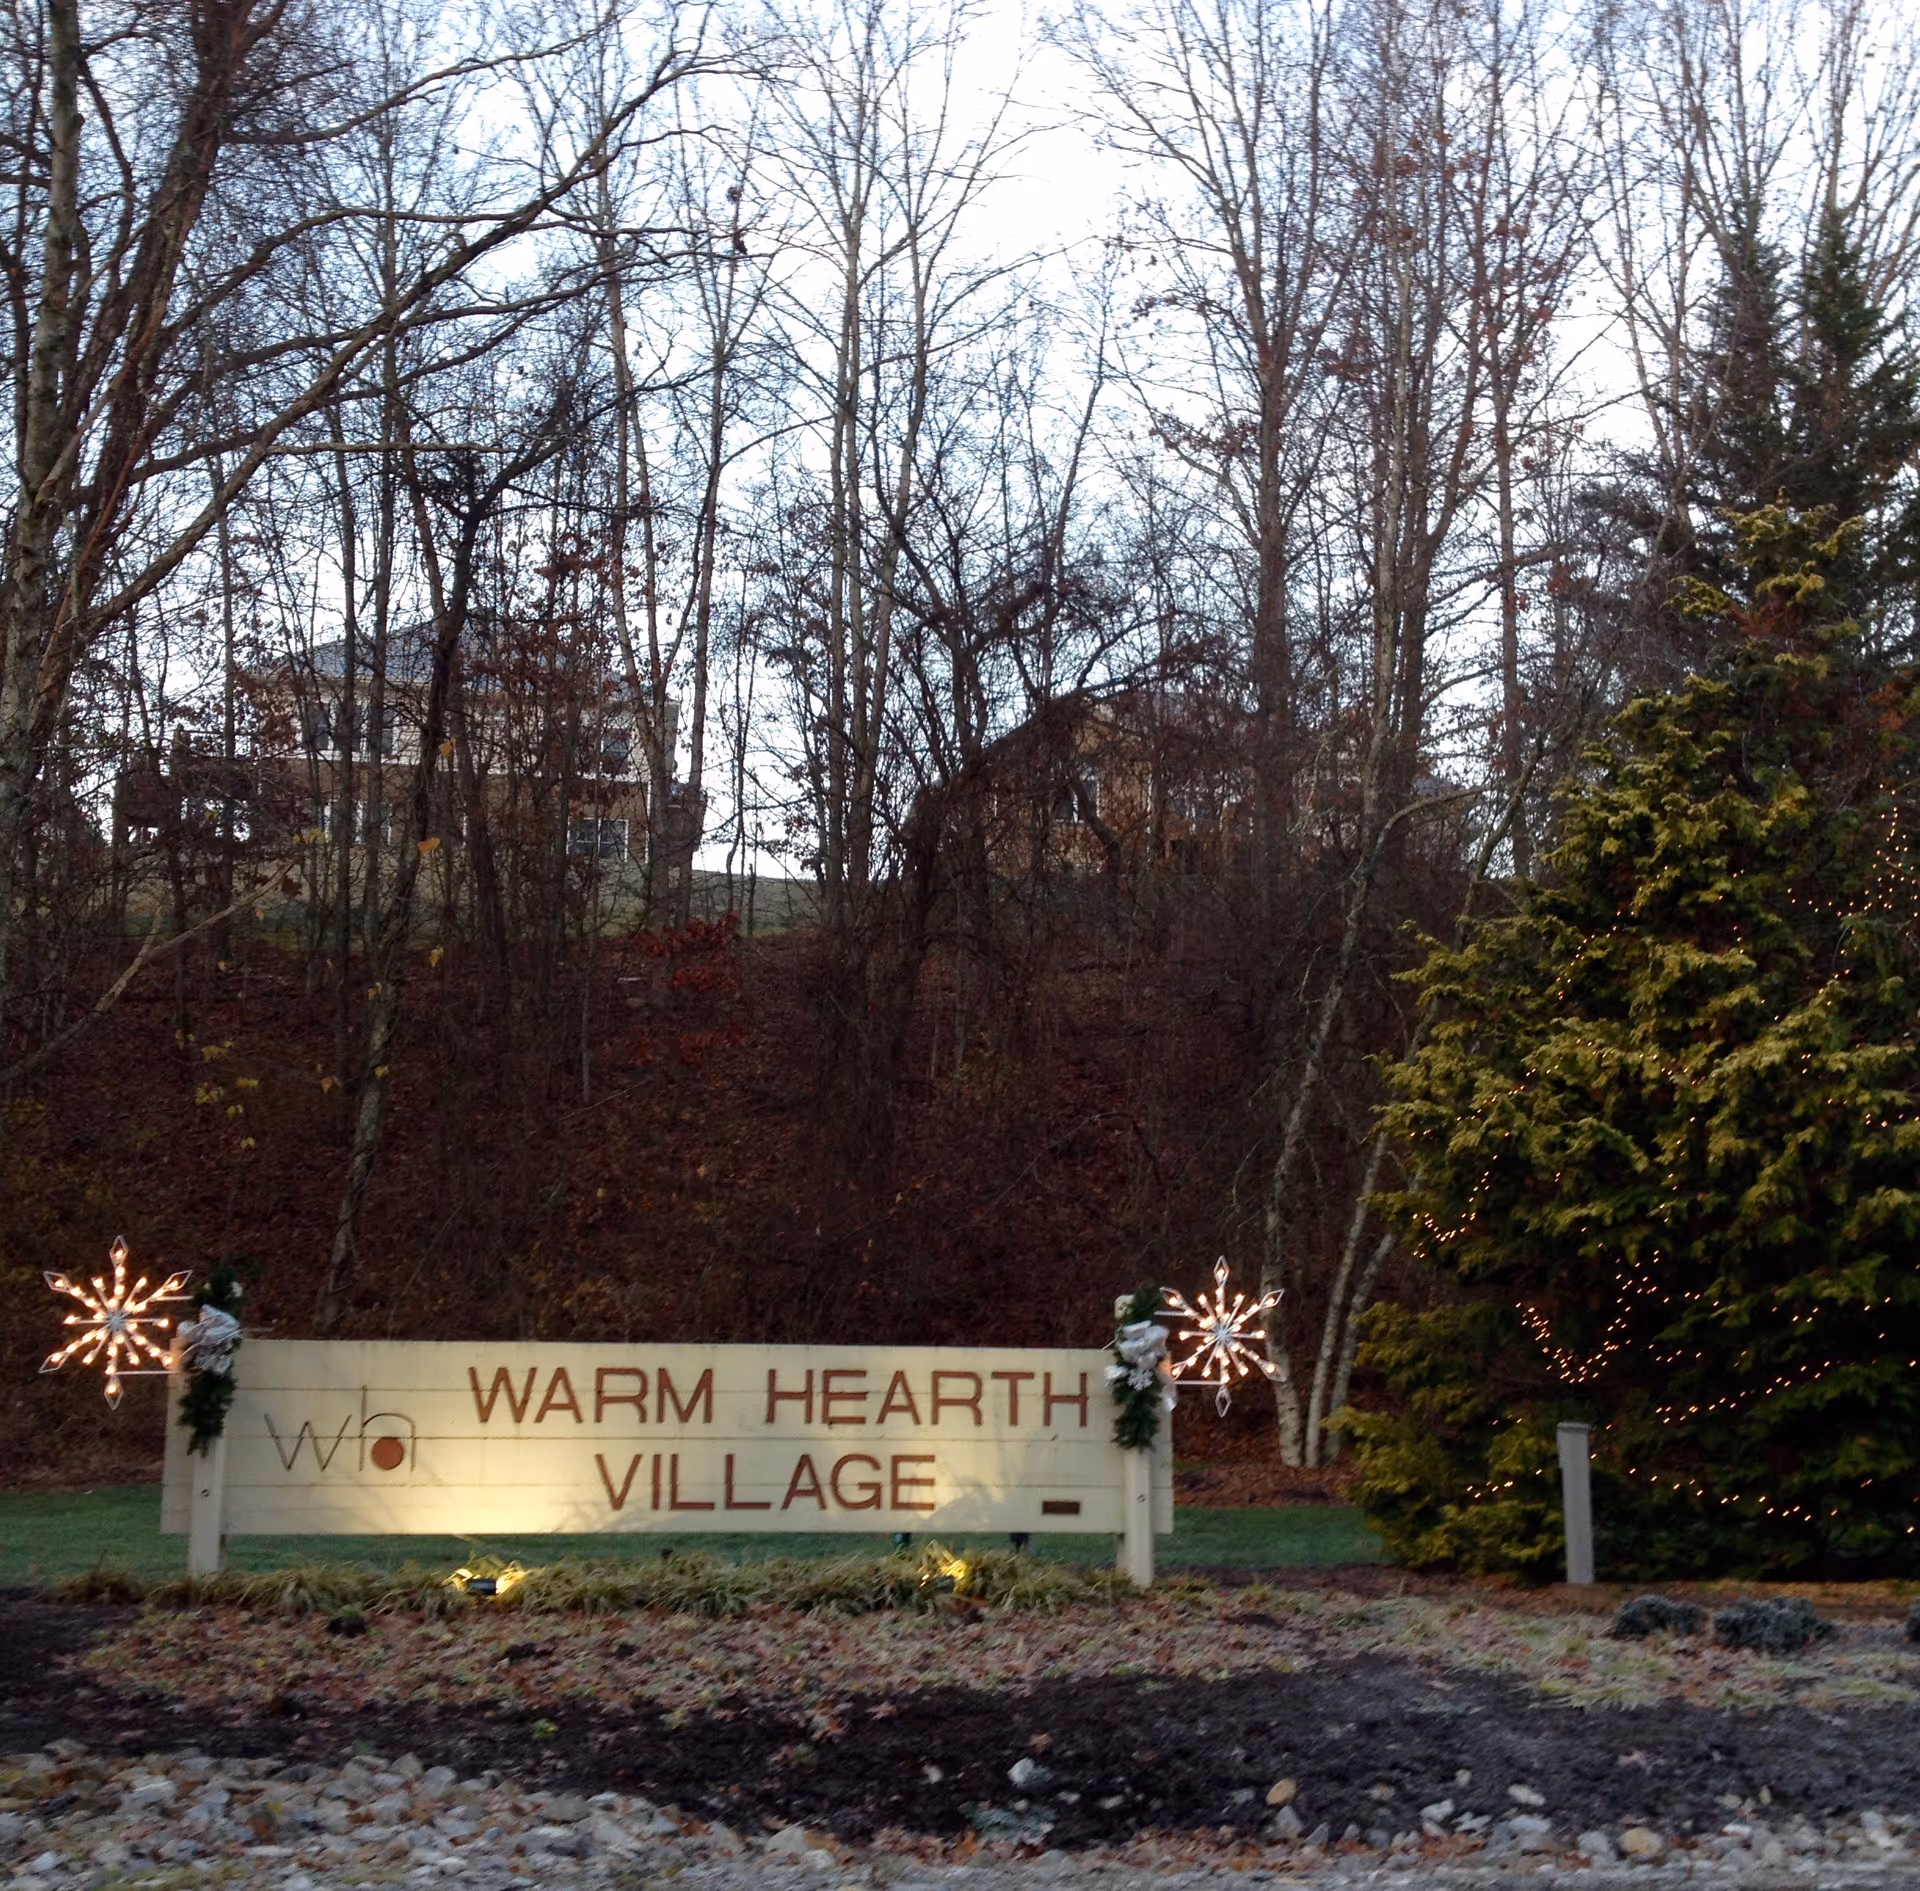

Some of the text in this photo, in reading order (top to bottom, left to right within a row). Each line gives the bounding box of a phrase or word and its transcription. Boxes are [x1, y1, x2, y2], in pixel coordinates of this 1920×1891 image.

[468, 1366, 1088, 1427] WARM HEARTH
[594, 1452, 936, 1511] VILLAGE
